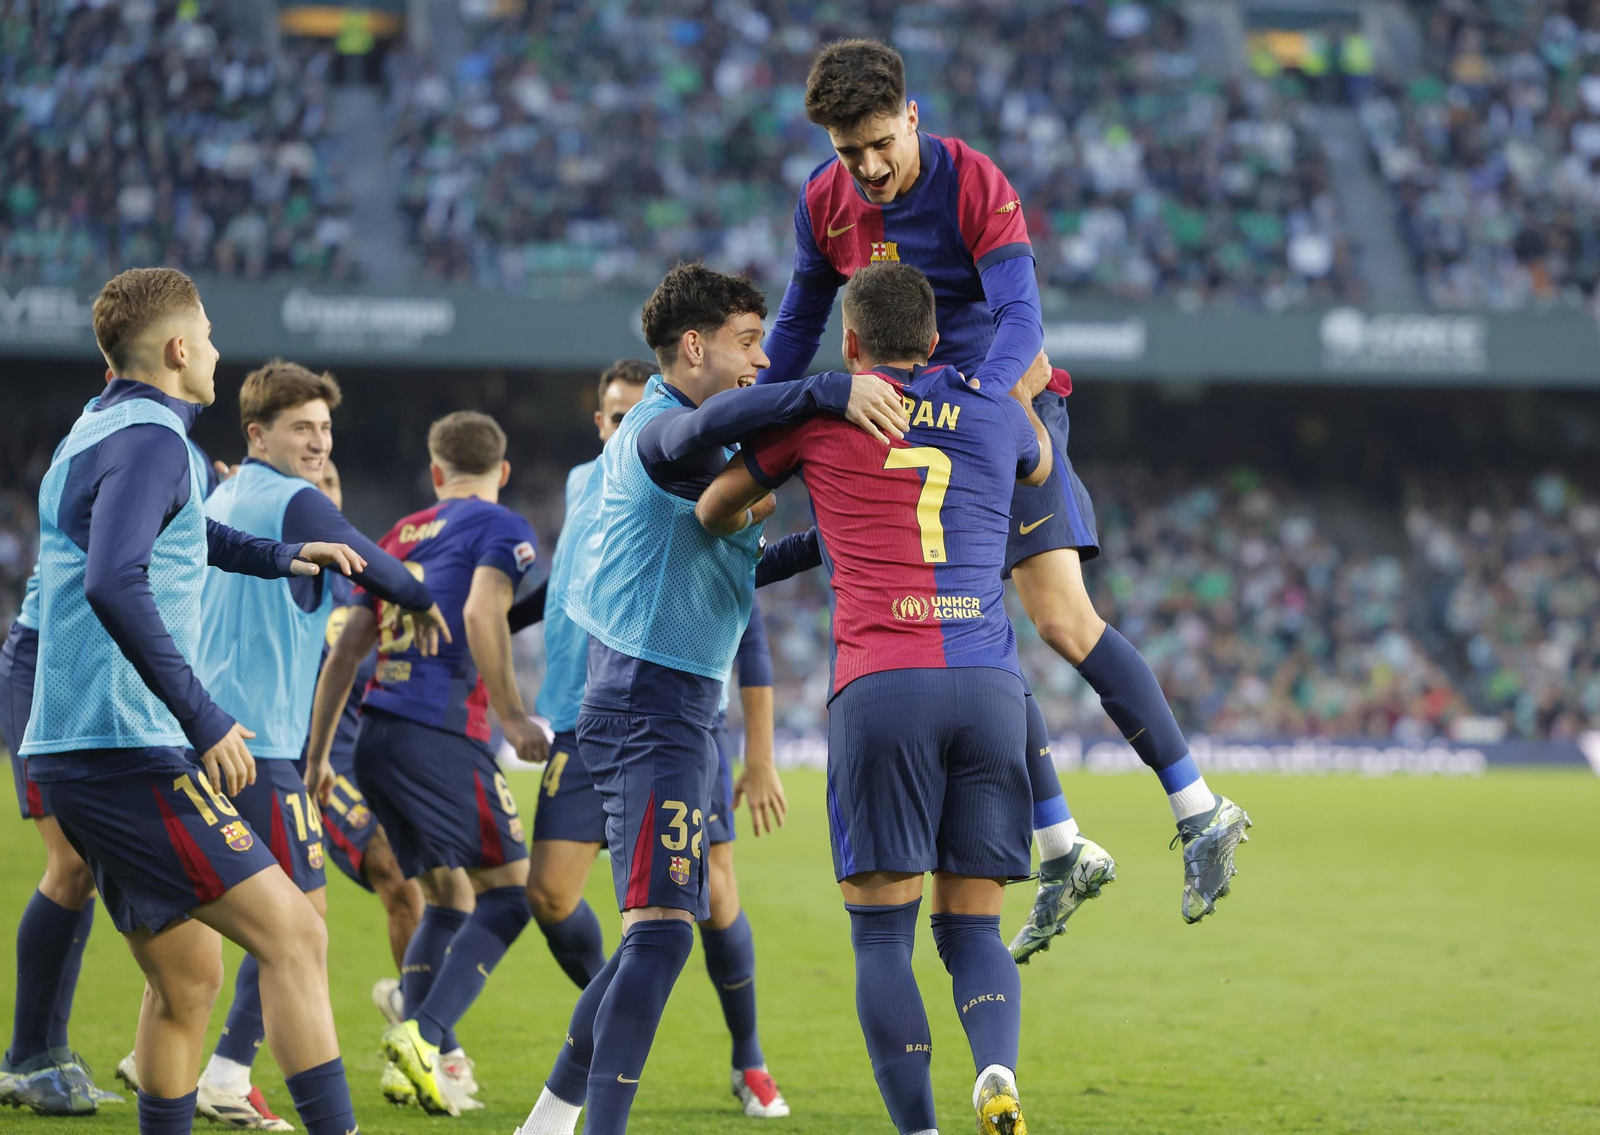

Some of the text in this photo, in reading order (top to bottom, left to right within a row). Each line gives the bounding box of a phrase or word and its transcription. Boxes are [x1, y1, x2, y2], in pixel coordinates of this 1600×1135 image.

[903, 395, 961, 430] RAN
[883, 447, 952, 563] 7
[930, 596, 980, 609] UNHCR
[494, 771, 517, 816] 6
[543, 751, 569, 797] 4
[173, 770, 238, 826] 16
[286, 792, 323, 841] 14
[661, 800, 703, 859] 32
[906, 1043, 932, 1053] BAR
